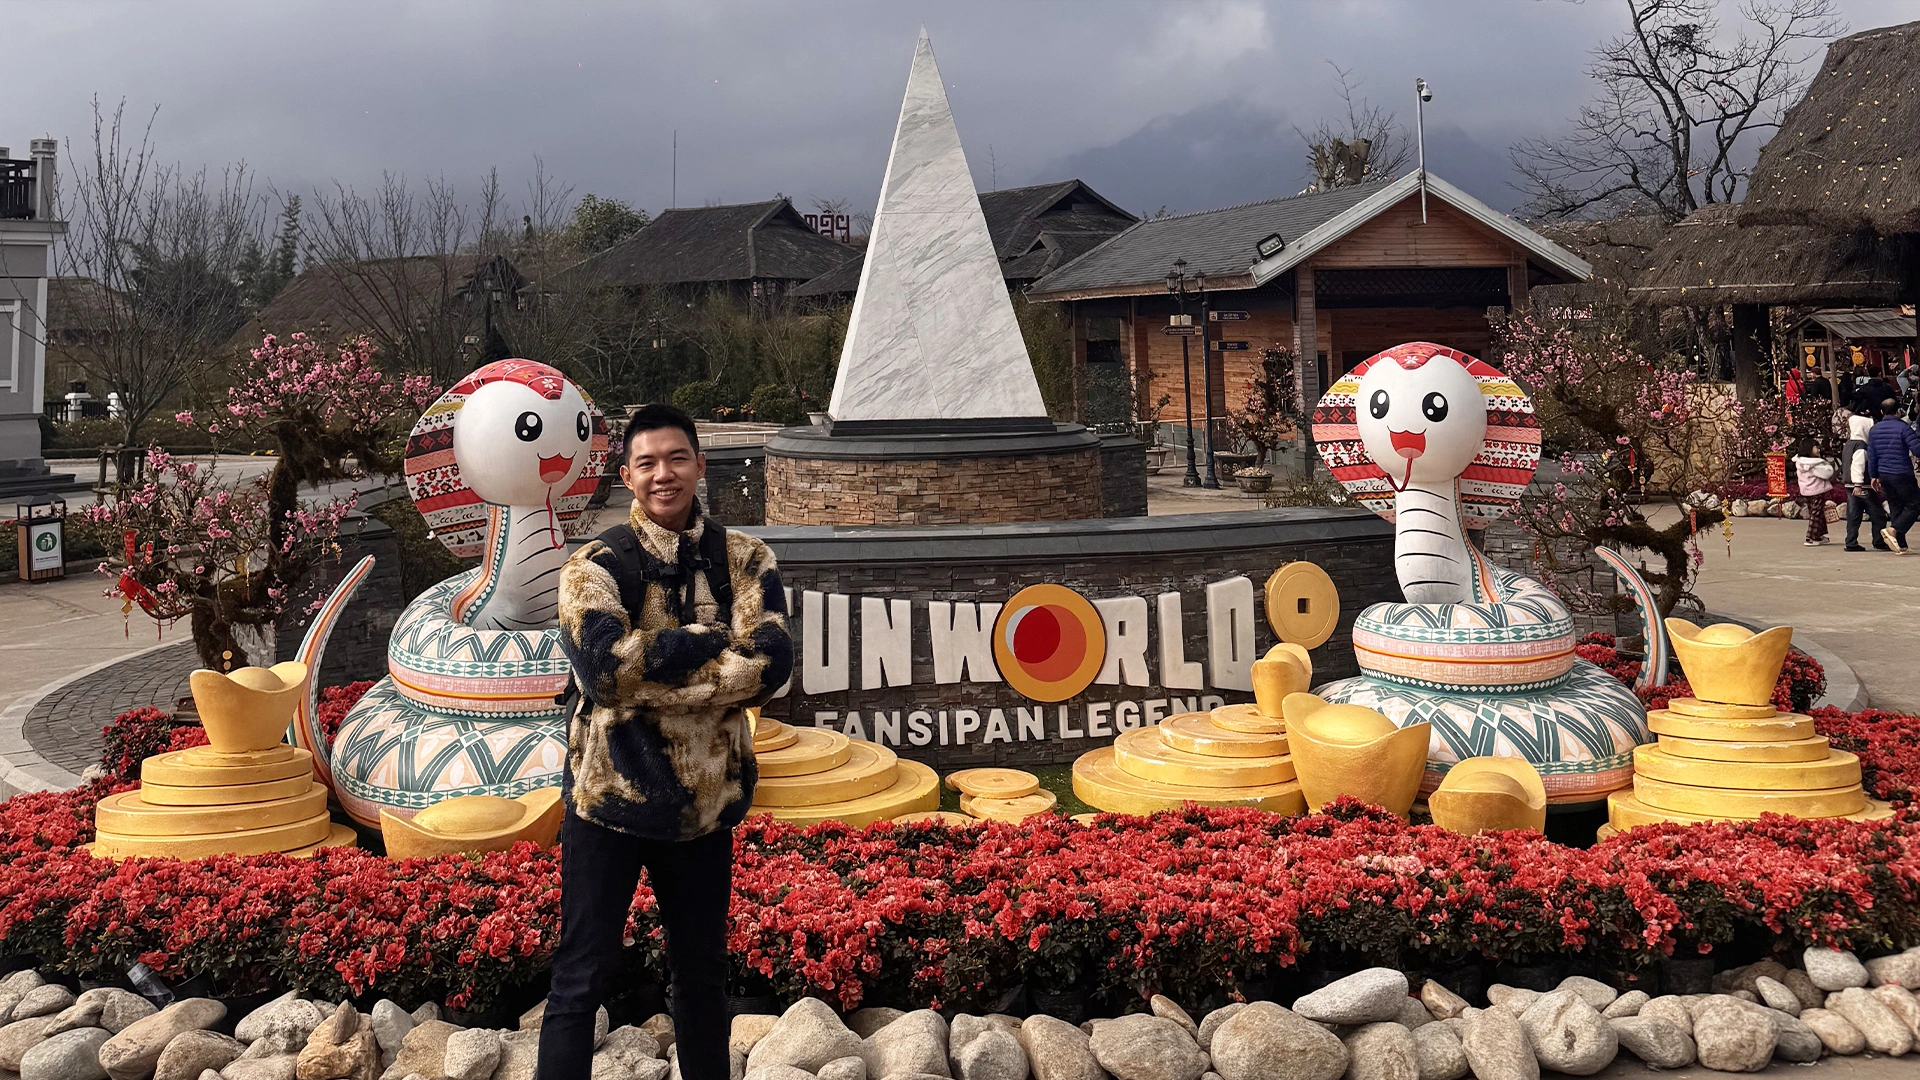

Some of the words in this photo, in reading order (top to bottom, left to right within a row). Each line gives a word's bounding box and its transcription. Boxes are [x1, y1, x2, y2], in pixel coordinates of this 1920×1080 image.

[772, 586, 912, 699] UN
[928, 576, 1256, 702] WORLD
[815, 706, 1045, 746] FANSIPAN
